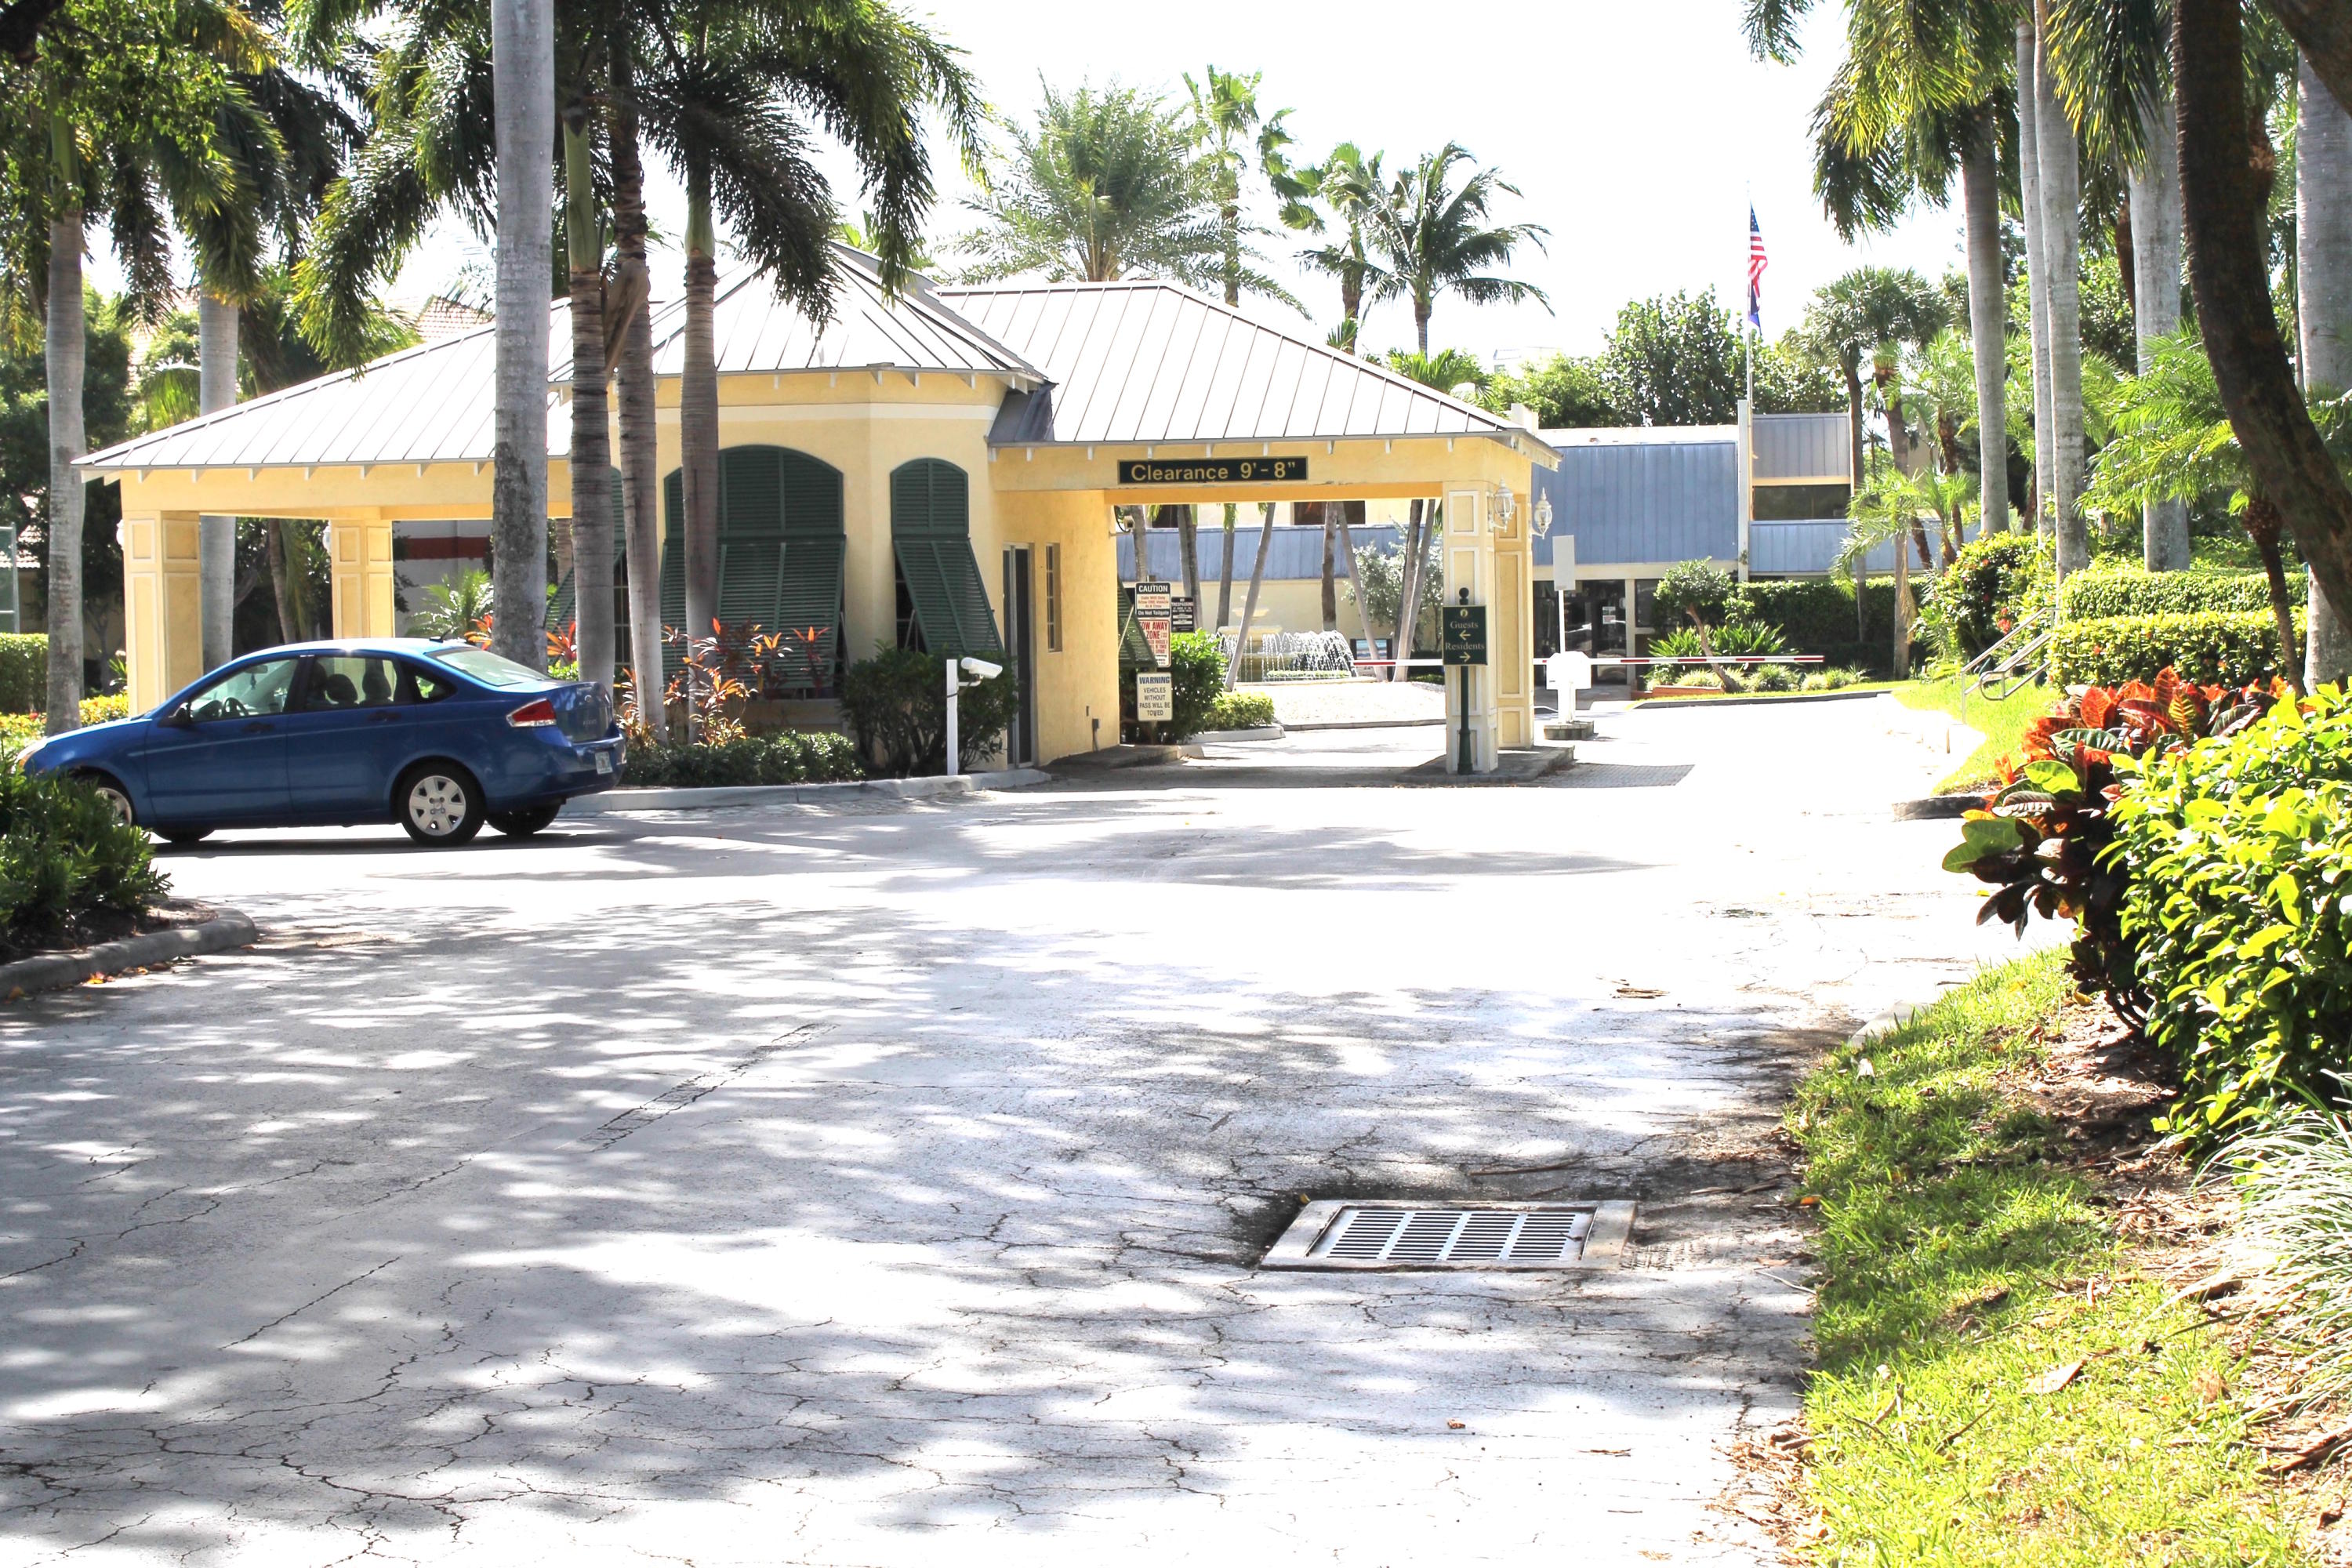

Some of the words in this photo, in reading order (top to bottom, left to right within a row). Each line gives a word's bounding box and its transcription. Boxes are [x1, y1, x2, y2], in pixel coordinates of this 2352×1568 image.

[1131, 463, 1229, 481] Clearance
[1152, 622, 1167, 630] AWAY
[1146, 630, 1160, 639] ZONE
